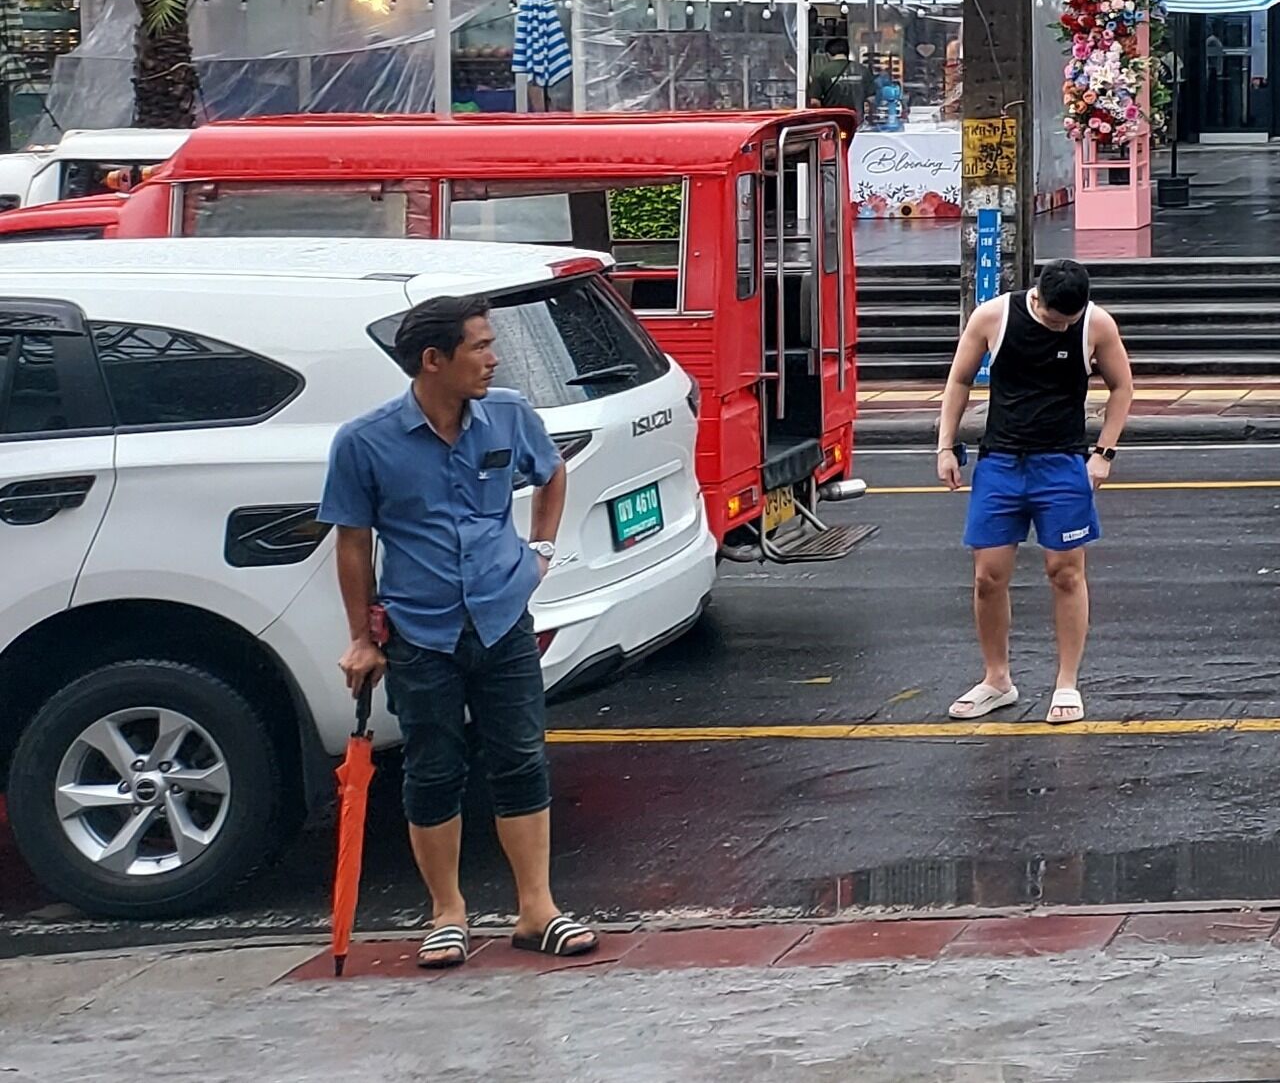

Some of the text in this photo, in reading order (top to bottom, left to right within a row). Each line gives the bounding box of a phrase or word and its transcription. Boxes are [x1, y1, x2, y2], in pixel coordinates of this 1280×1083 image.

[862, 146, 946, 176] Blooming
[632, 408, 673, 437] ISUZU
[635, 489, 658, 515] 4610
